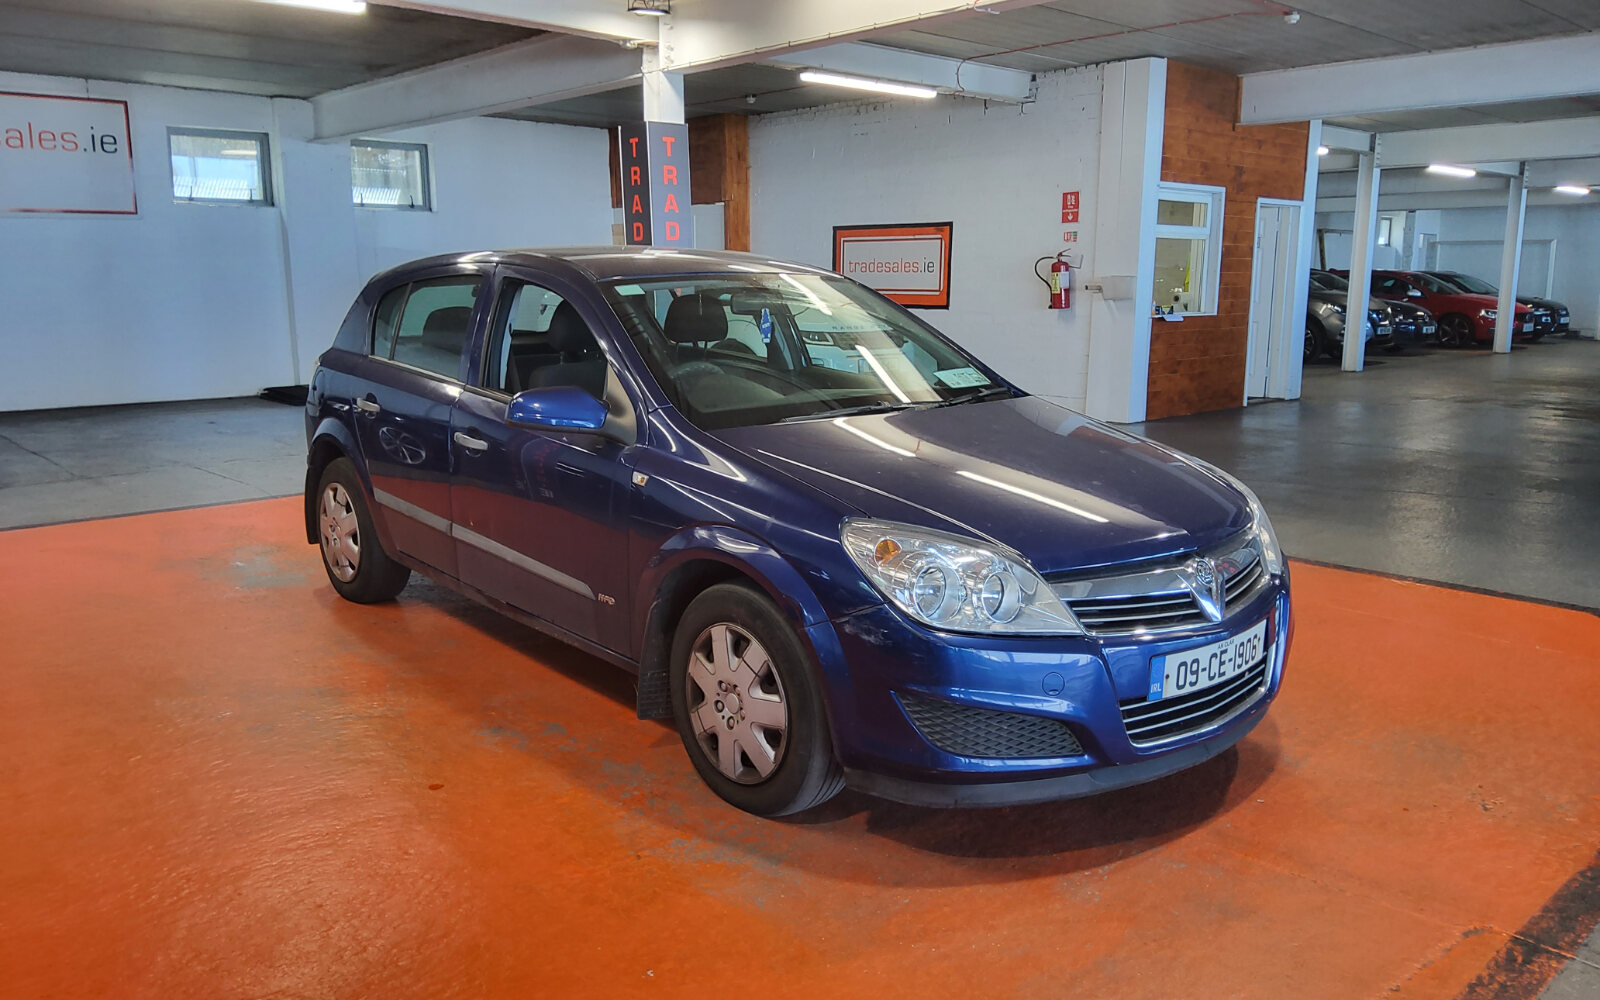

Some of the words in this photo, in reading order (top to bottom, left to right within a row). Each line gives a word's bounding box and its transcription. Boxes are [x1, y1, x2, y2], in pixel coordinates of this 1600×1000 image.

[0, 122, 118, 154] ales.ie
[848, 257, 935, 273] tradesales.ie
[1175, 633, 1259, 691] 09-CE-1906
[1150, 684, 1161, 693] IRL
